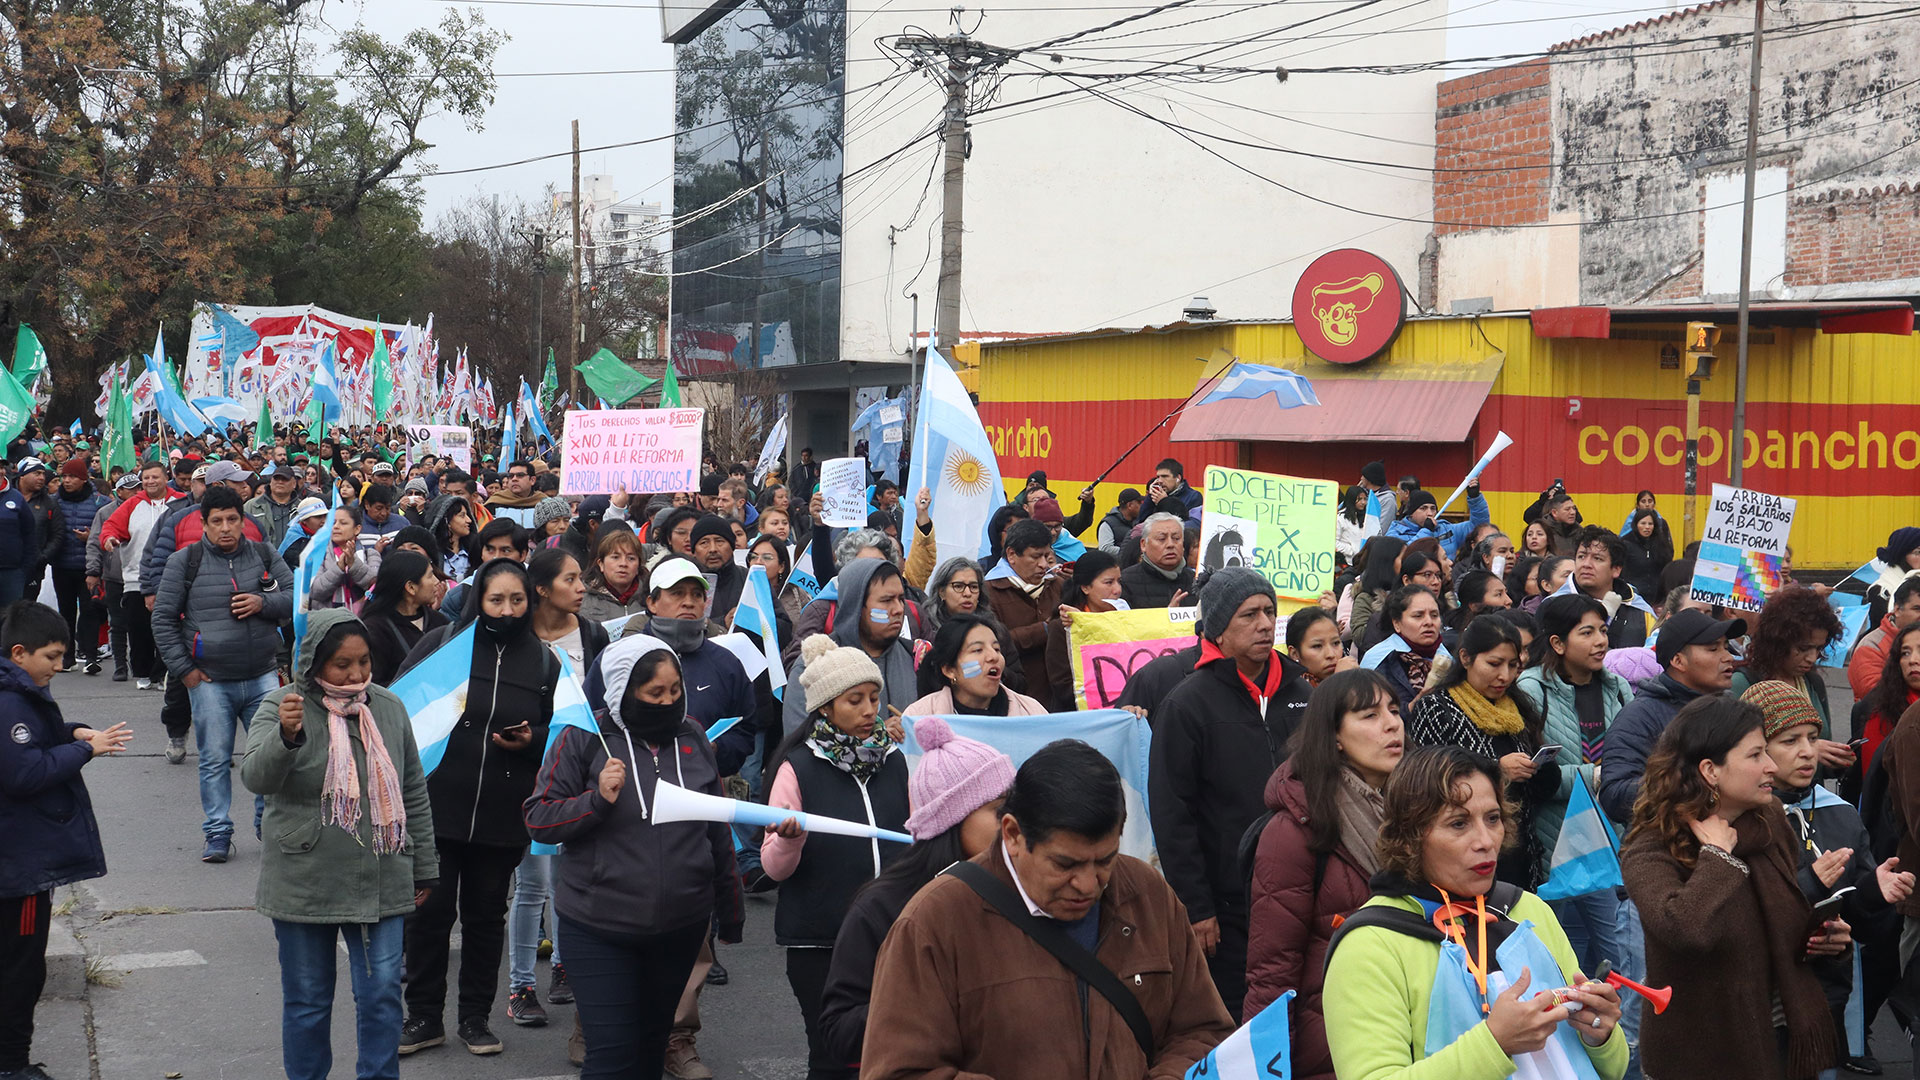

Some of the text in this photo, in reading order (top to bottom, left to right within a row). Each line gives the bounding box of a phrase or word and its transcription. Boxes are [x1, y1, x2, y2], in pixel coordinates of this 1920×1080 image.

[601, 417, 641, 428] DERECHOS
[645, 416, 666, 426] VALEN
[405, 427, 431, 447] NO
[607, 434, 617, 448] AL
[603, 450, 610, 464] A
[614, 450, 627, 464] LA
[630, 448, 684, 463] REFORMA
[606, 470, 627, 492] LOS
[1208, 469, 1328, 506] DOCENTE
[1216, 498, 1289, 526] DE PIE
[1715, 500, 1734, 513] LOS
[1725, 513, 1773, 532] ABAJO
[1277, 528, 1300, 552] X
[1707, 527, 1778, 551] LA REFORMA
[1252, 547, 1333, 574] SALARIO
[1691, 588, 1725, 606] DOCENTE
[1726, 594, 1739, 608] EN
[1170, 611, 1191, 621] DIA
